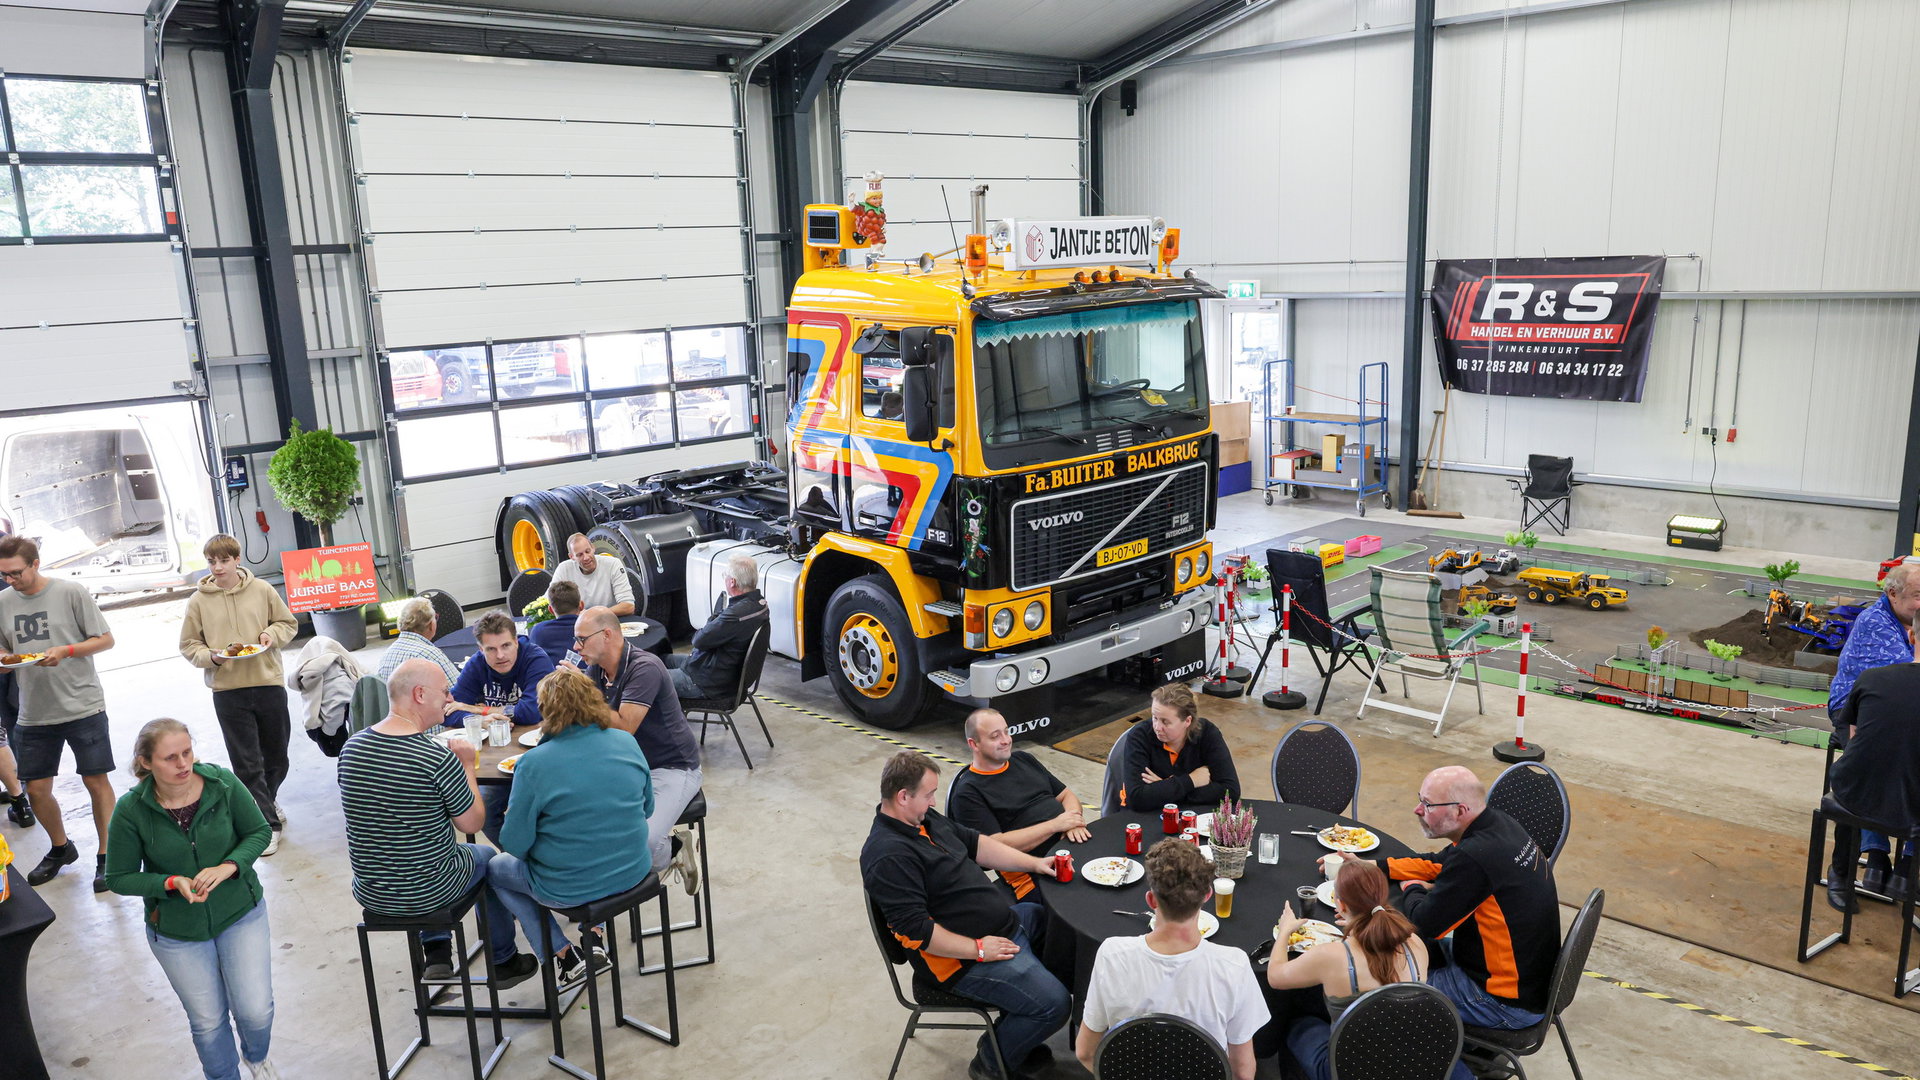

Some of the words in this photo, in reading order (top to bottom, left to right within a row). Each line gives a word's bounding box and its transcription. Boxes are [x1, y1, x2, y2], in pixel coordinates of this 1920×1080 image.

[1050, 227, 1102, 260] JANTJE
[1105, 225, 1150, 256] BETON
[1471, 326, 1514, 338] HANDEL
[1517, 327, 1534, 338] EN
[1536, 327, 1590, 339] VERHUUR
[1593, 328, 1615, 340] B.V.
[1498, 345, 1581, 354] VINKENBUURT
[1457, 358, 1468, 371] 06
[1471, 360, 1483, 371] 37
[1486, 360, 1506, 372] 285
[1508, 361, 1530, 374] 284
[1538, 362, 1553, 375] 06
[1556, 363, 1571, 375] 34
[1573, 363, 1589, 376] 34
[1592, 364, 1605, 376] 17
[1607, 364, 1624, 377] 22
[1127, 441, 1199, 473] BALKBRUG
[1028, 510, 1084, 531] VOLVO
[1172, 512, 1190, 528] F12
[926, 528, 947, 543] F12
[318, 545, 369, 555] TUINCENTRUM
[1103, 541, 1143, 564] BJ-07-VD
[290, 583, 337, 598] JURRIE
[339, 578, 375, 592] BAAS
[1164, 659, 1205, 682] VOLVO
[1008, 716, 1051, 737] OLVO
